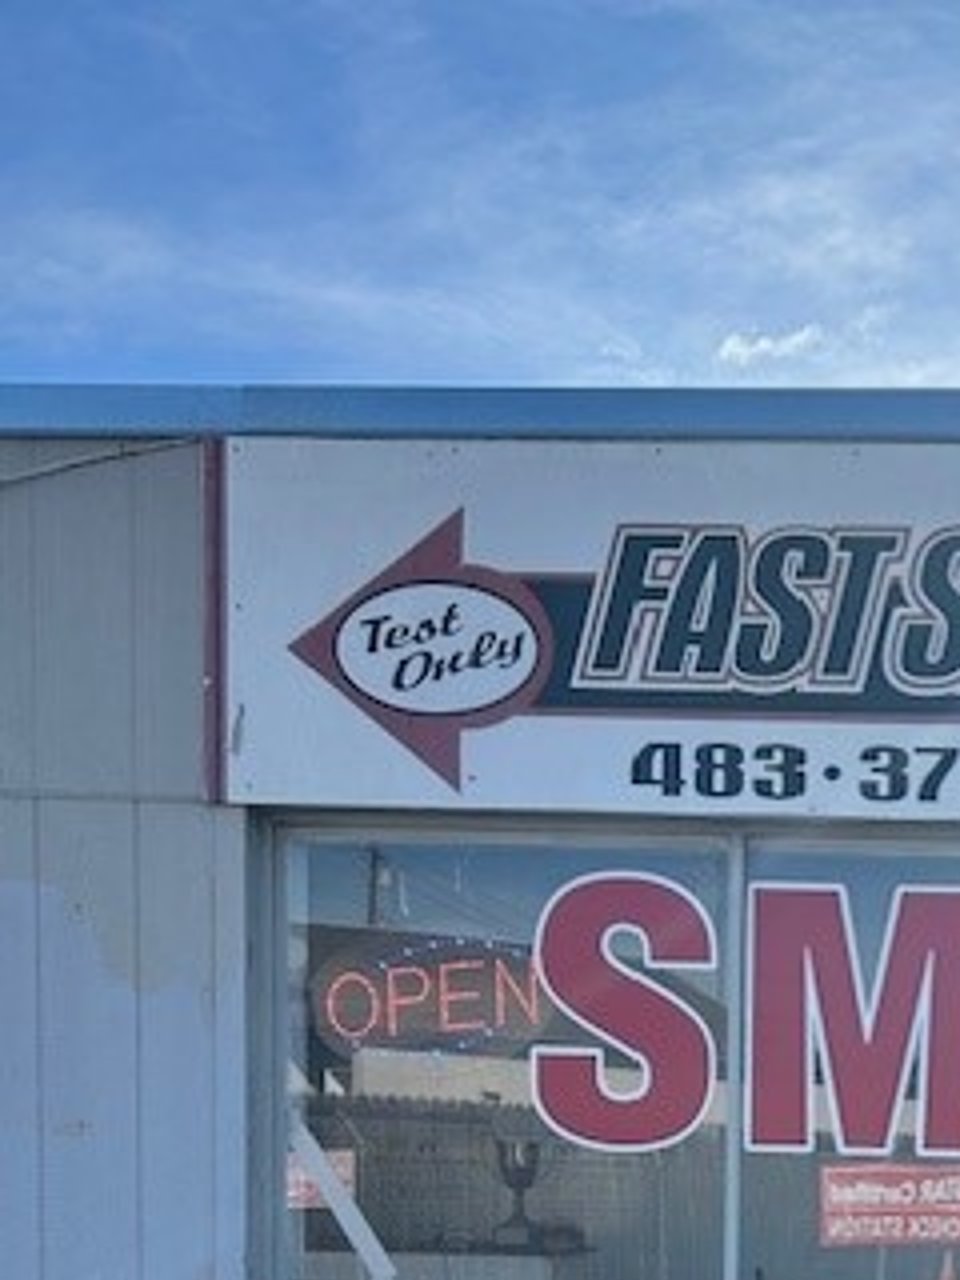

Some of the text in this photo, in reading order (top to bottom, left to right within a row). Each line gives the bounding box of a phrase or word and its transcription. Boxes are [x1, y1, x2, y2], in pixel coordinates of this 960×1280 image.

[360, 602, 465, 655] Test
[571, 525, 907, 694] FAST
[390, 630, 530, 692] Only
[326, 958, 541, 1038] OPEN
